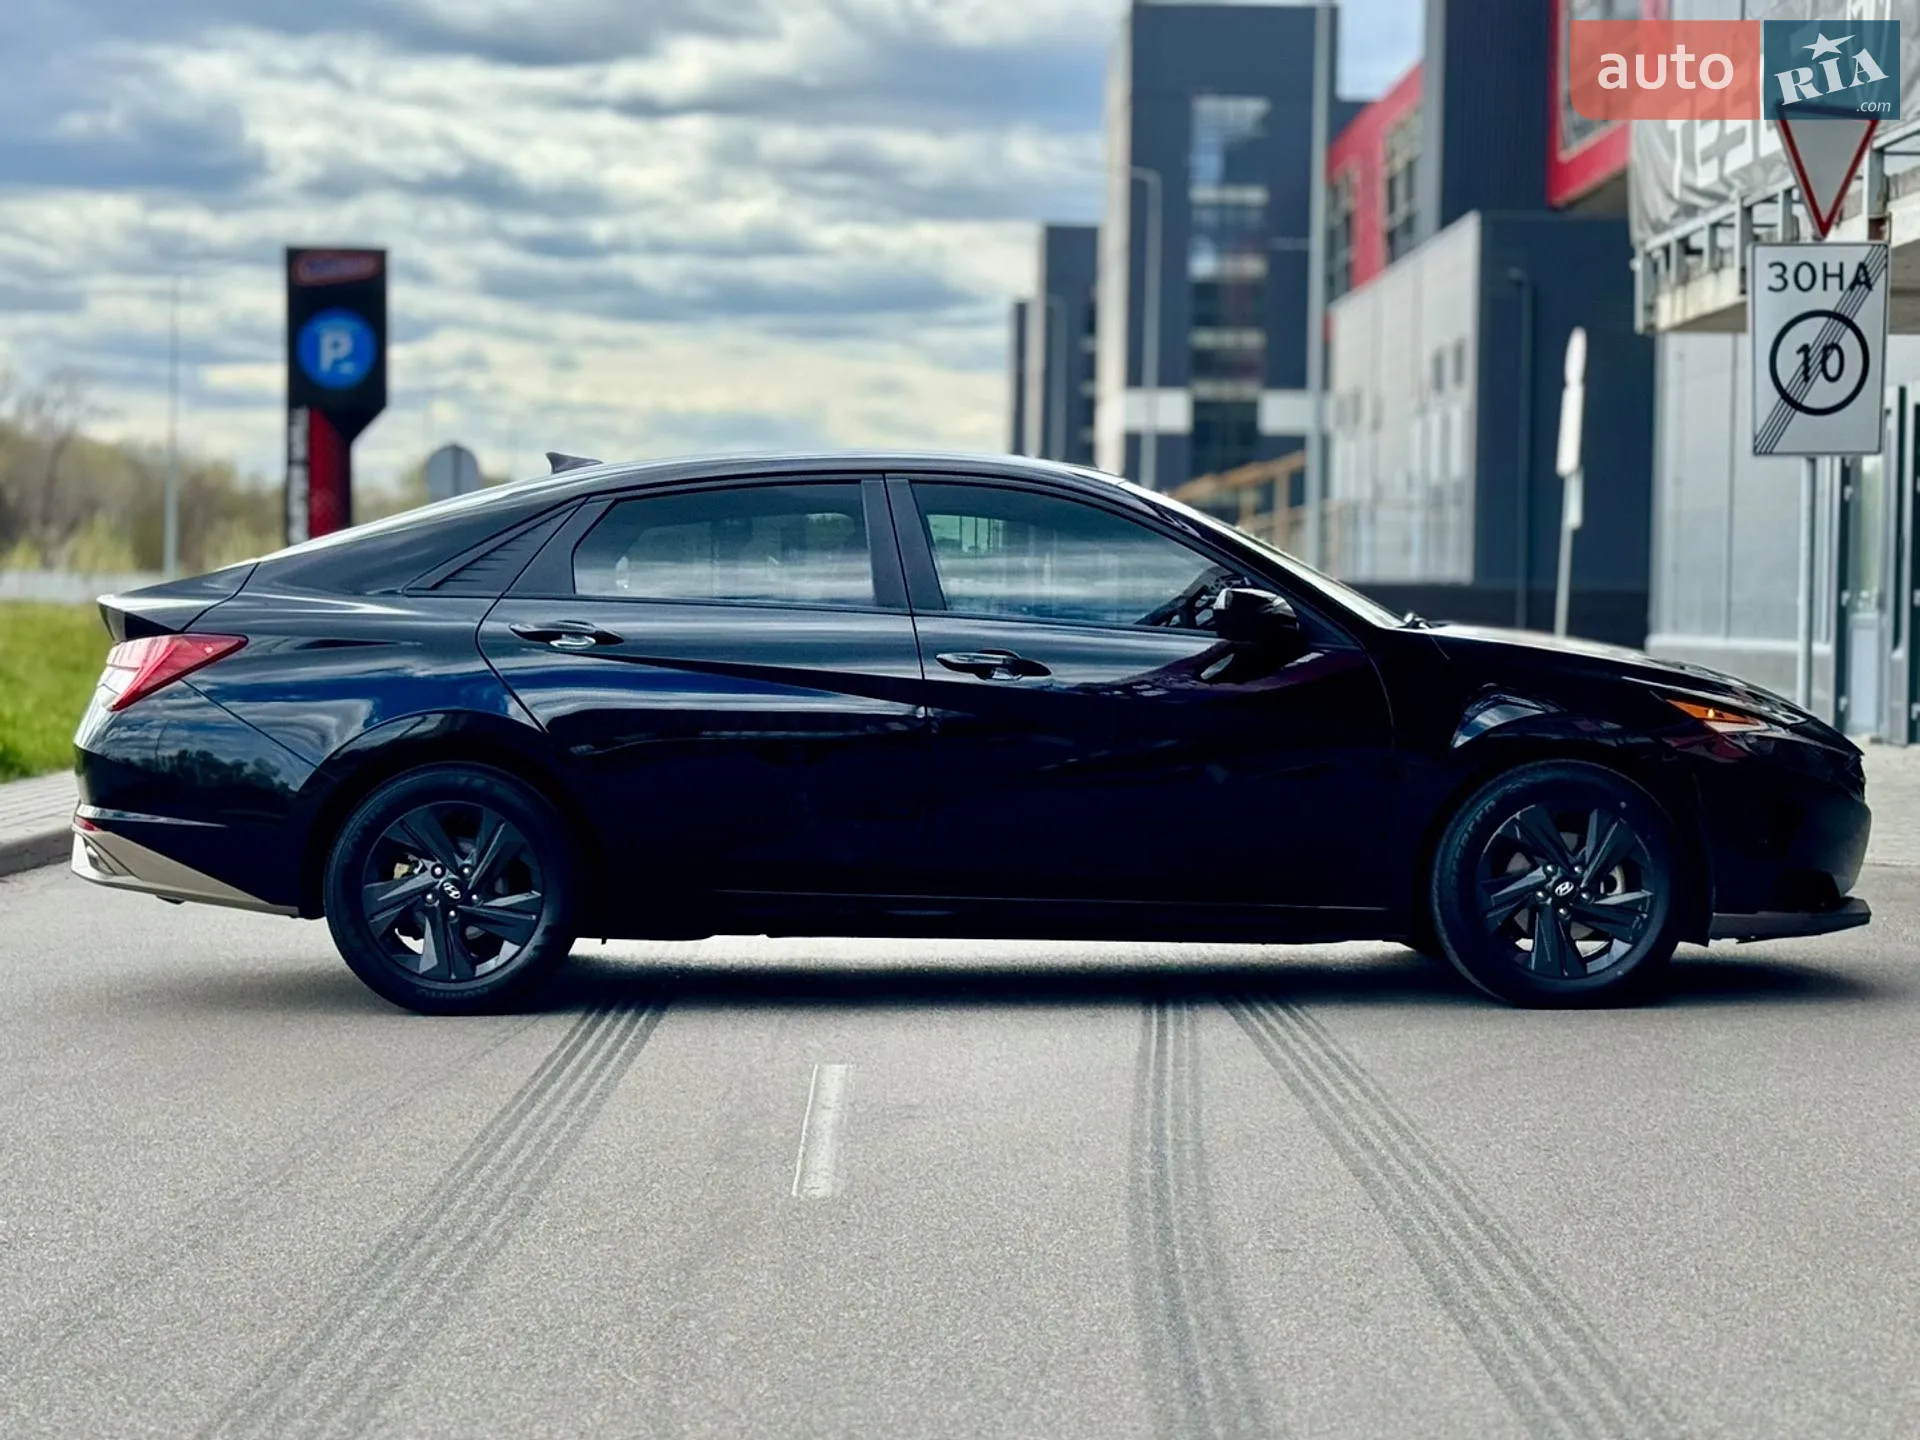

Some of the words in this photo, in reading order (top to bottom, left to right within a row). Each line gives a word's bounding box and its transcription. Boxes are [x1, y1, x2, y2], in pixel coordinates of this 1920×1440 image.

[1767, 261, 1873, 292] ЗОНА
[319, 328, 354, 374] P
[1796, 343, 1845, 383] 10
